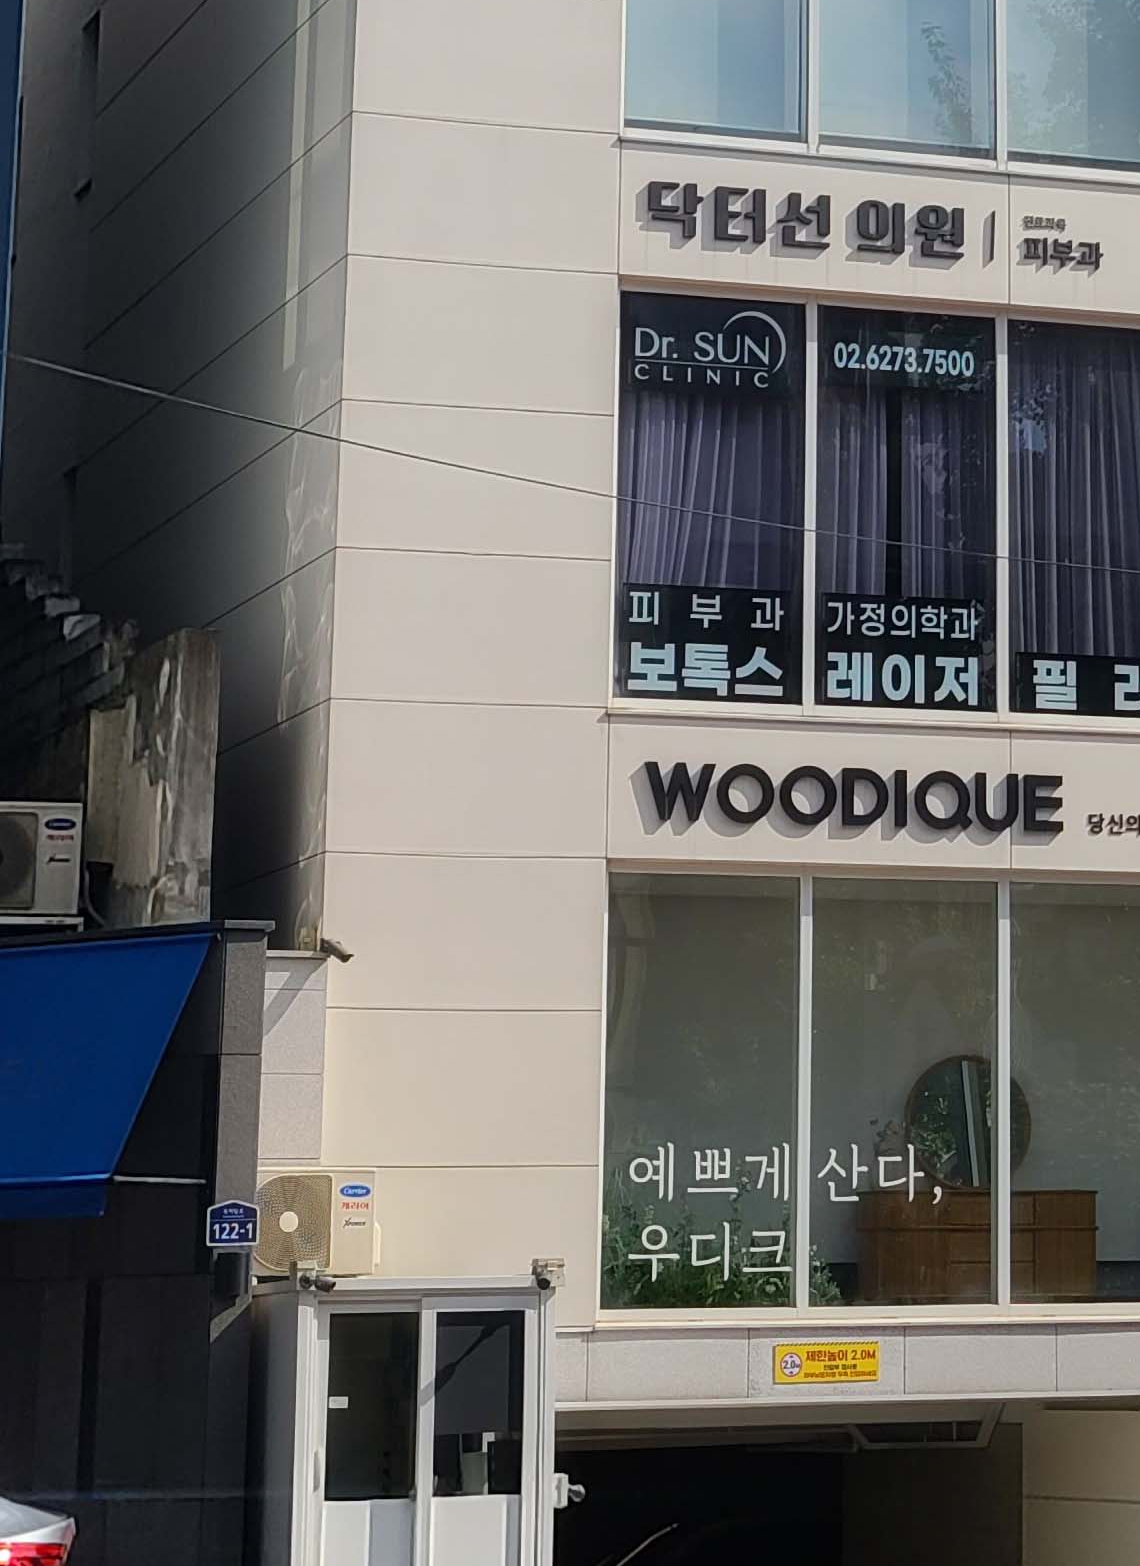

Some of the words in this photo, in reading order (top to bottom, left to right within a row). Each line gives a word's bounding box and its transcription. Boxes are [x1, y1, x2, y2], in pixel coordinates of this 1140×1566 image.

[647, 181, 832, 251] 닥터선
[855, 198, 965, 260] 의원
[1023, 237, 1104, 271] 피부과
[633, 326, 679, 360] Dr.
[693, 330, 770, 366] SUN
[833, 342, 976, 377] 02.6273.7500
[633, 363, 769, 389] CLINIC
[826, 600, 980, 641] 가정의학과
[627, 641, 784, 697] 보톡스
[826, 651, 979, 707] 레이저
[643, 760, 1064, 833] WOODIQUE
[628, 1141, 791, 1203] 예쁘게
[817, 1142, 943, 1206] 산다,
[212, 1222, 254, 1240] 122-1
[627, 1221, 793, 1283] 우디크
[806, 1350, 848, 1362] 제한높이
[851, 1350, 876, 1361] 2.0M
